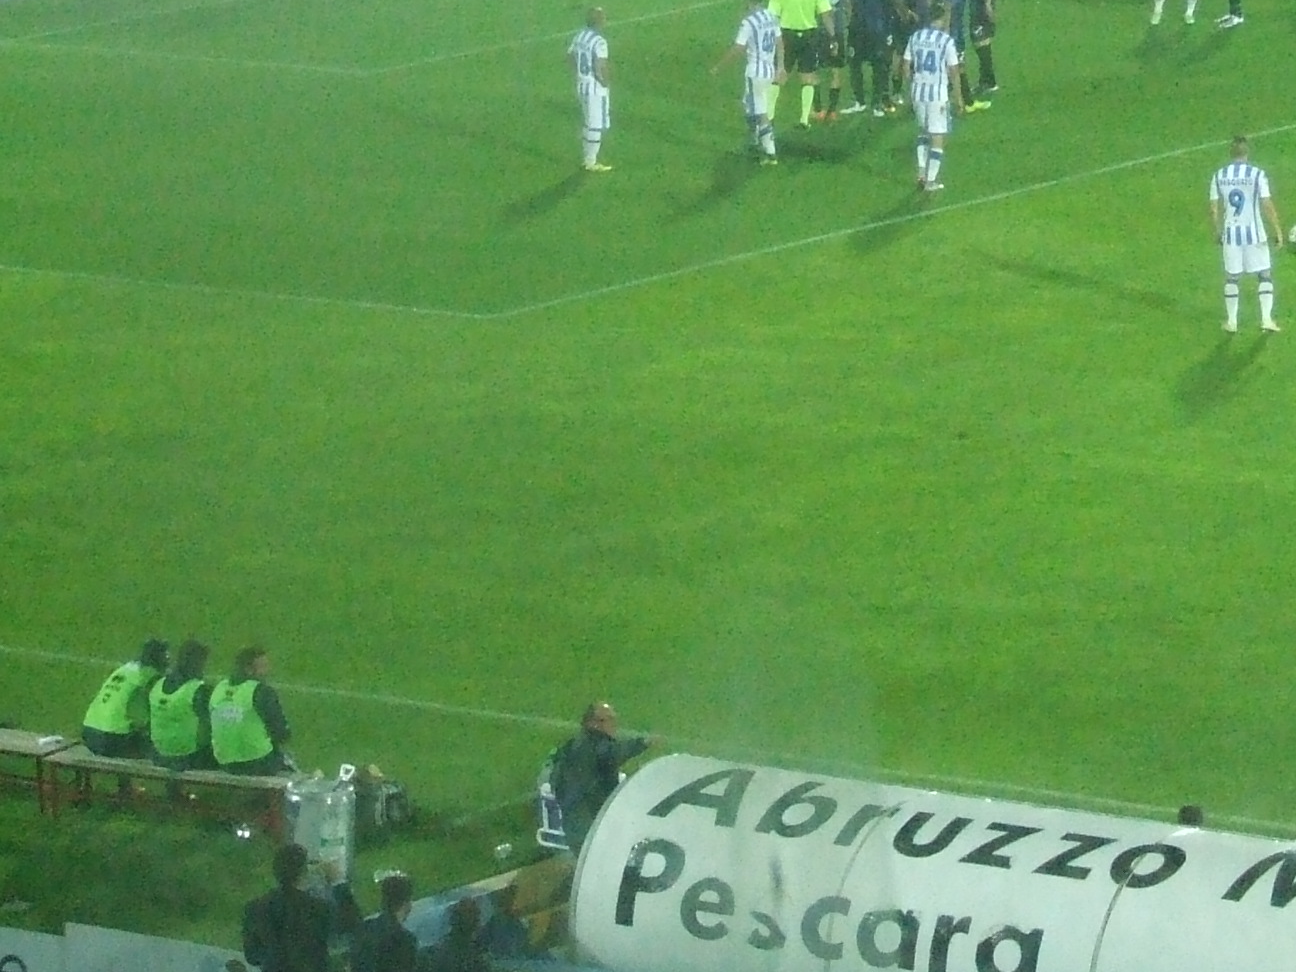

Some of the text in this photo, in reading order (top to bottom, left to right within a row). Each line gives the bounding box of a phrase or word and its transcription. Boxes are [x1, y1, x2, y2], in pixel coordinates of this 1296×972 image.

[1228, 188, 1246, 217] 9
[647, 768, 1188, 890] Abruzzo
[615, 838, 1044, 972] Pescara
